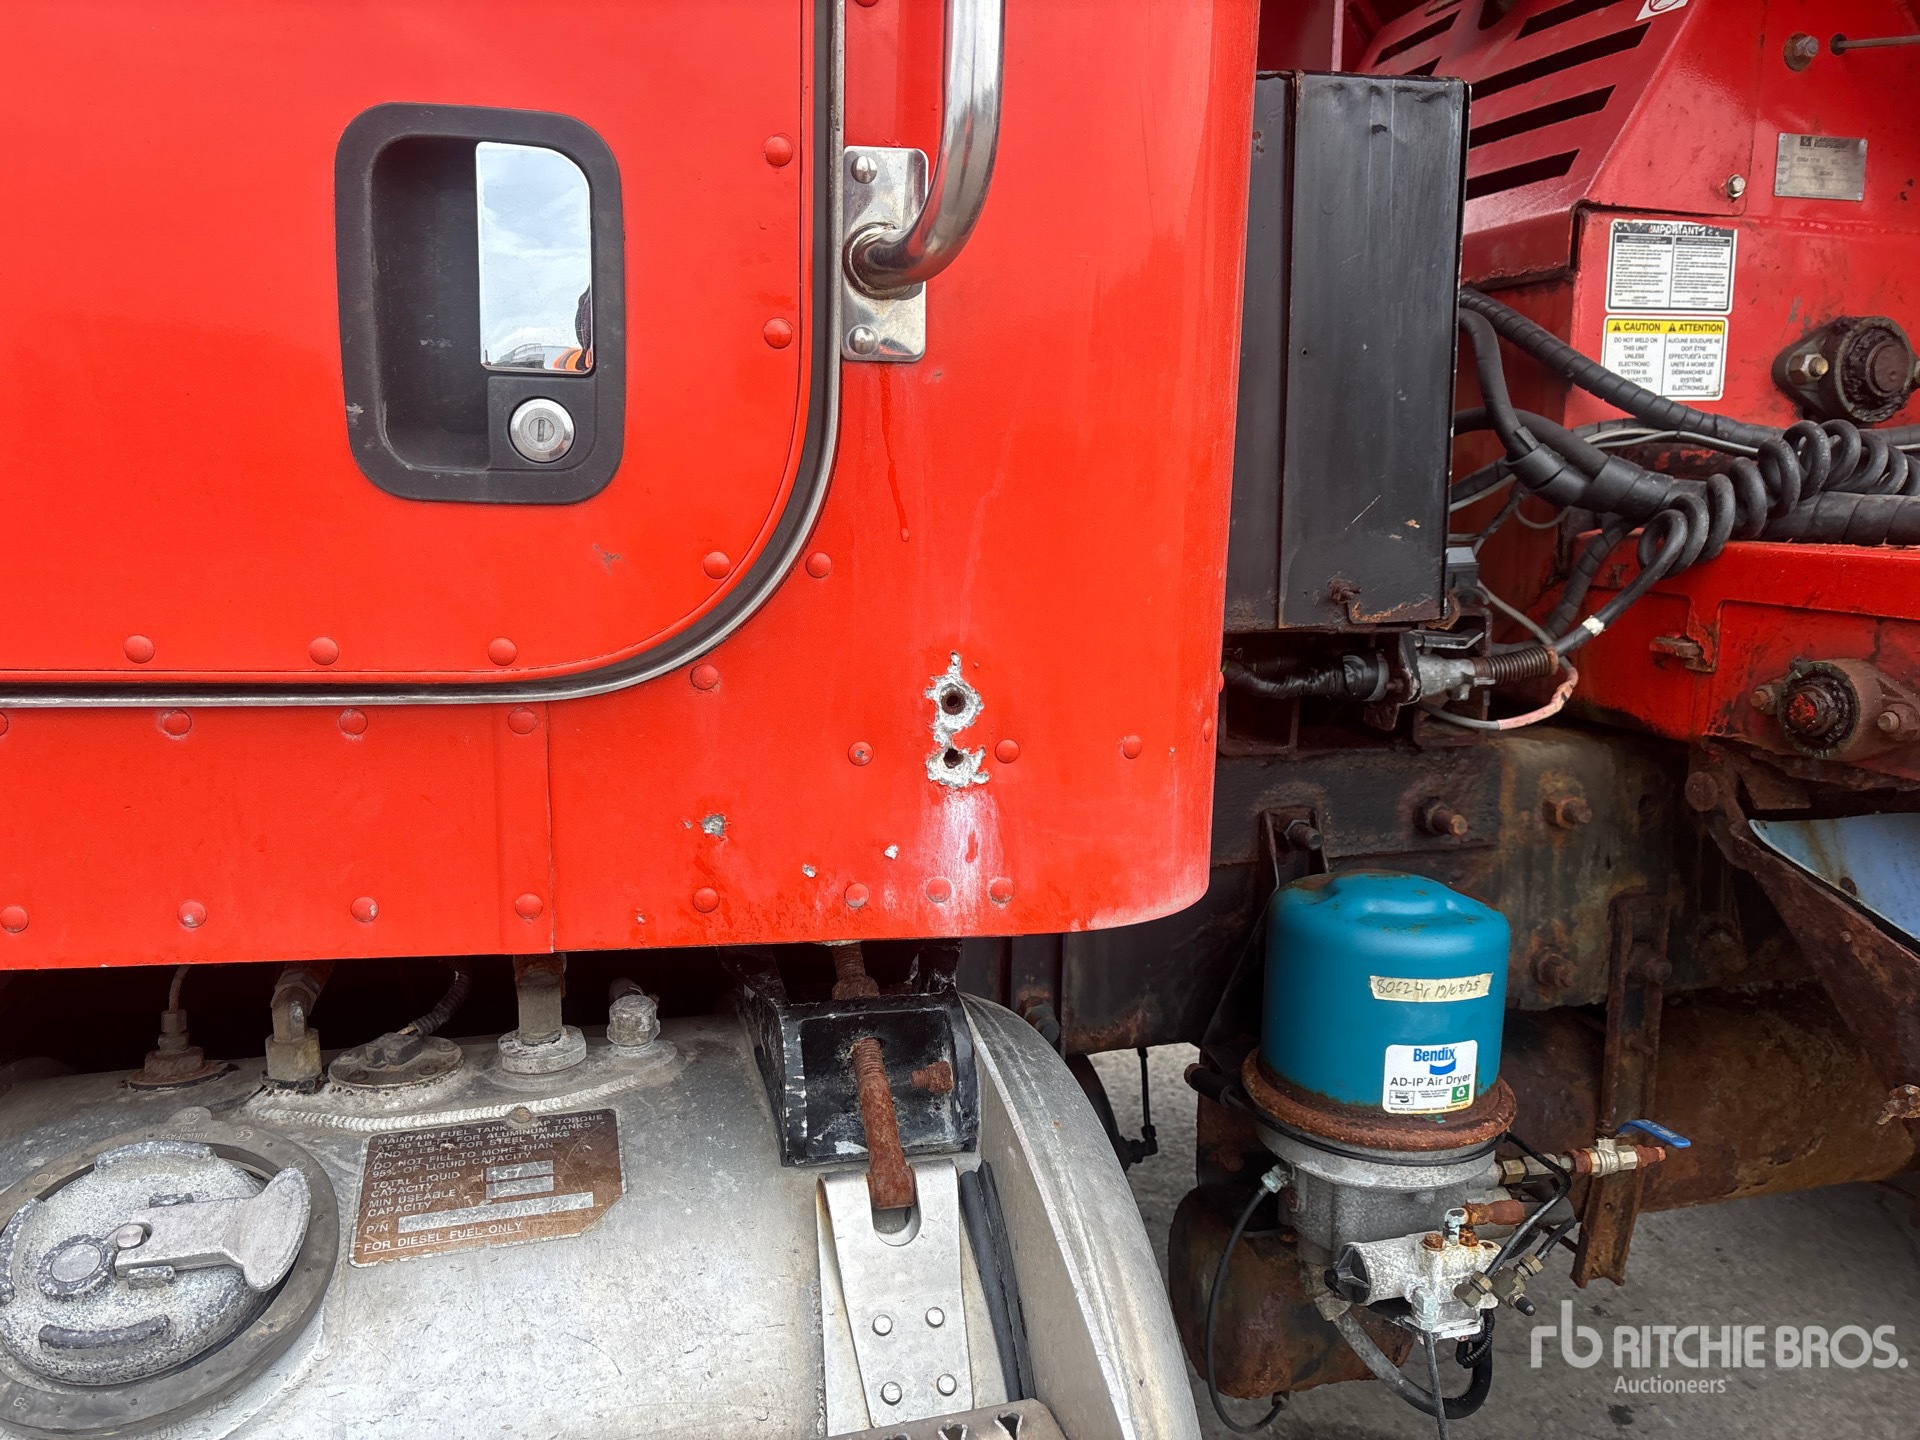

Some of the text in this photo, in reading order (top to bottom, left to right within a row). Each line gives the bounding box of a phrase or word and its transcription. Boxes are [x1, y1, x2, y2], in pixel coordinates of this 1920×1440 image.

[1624, 323, 1661, 332] CAUTION
[1678, 323, 1723, 332] ATTENTION
[1413, 1047, 1456, 1062] Bendix
[1426, 1077, 1443, 1086] Air
[1446, 1073, 1472, 1086] Dryer
[376, 1145, 393, 1153] AT
[398, 1142, 412, 1150] 30
[456, 1134, 480, 1142] FOR
[486, 1126, 548, 1139] ALUMINUM
[553, 1121, 592, 1132] TANKS
[377, 1133, 435, 1145] MAINTAIN
[440, 1129, 471, 1138] FUEL
[476, 1125, 507, 1133] TANK
[556, 1114, 604, 1125] TORQUE
[377, 1151, 401, 1159] AND
[459, 1141, 483, 1149] FOR
[489, 1137, 527, 1146] STEEL
[531, 1130, 570, 1141] TANKS
[372, 1151, 531, 1178] 95% OF LIQUID CAPACITY
[374, 1142, 554, 1170] DO NOT FILL TO MORE THAN
[371, 1171, 460, 1189] TOTAL LIQUID
[369, 1189, 456, 1208] MIN USEABLE
[371, 1182, 434, 1198] CAPACITY
[368, 1200, 432, 1217] CAPACITY
[364, 1222, 523, 1252] FOR DIESEL FUEL ONLY
[366, 1223, 389, 1234] P/N
